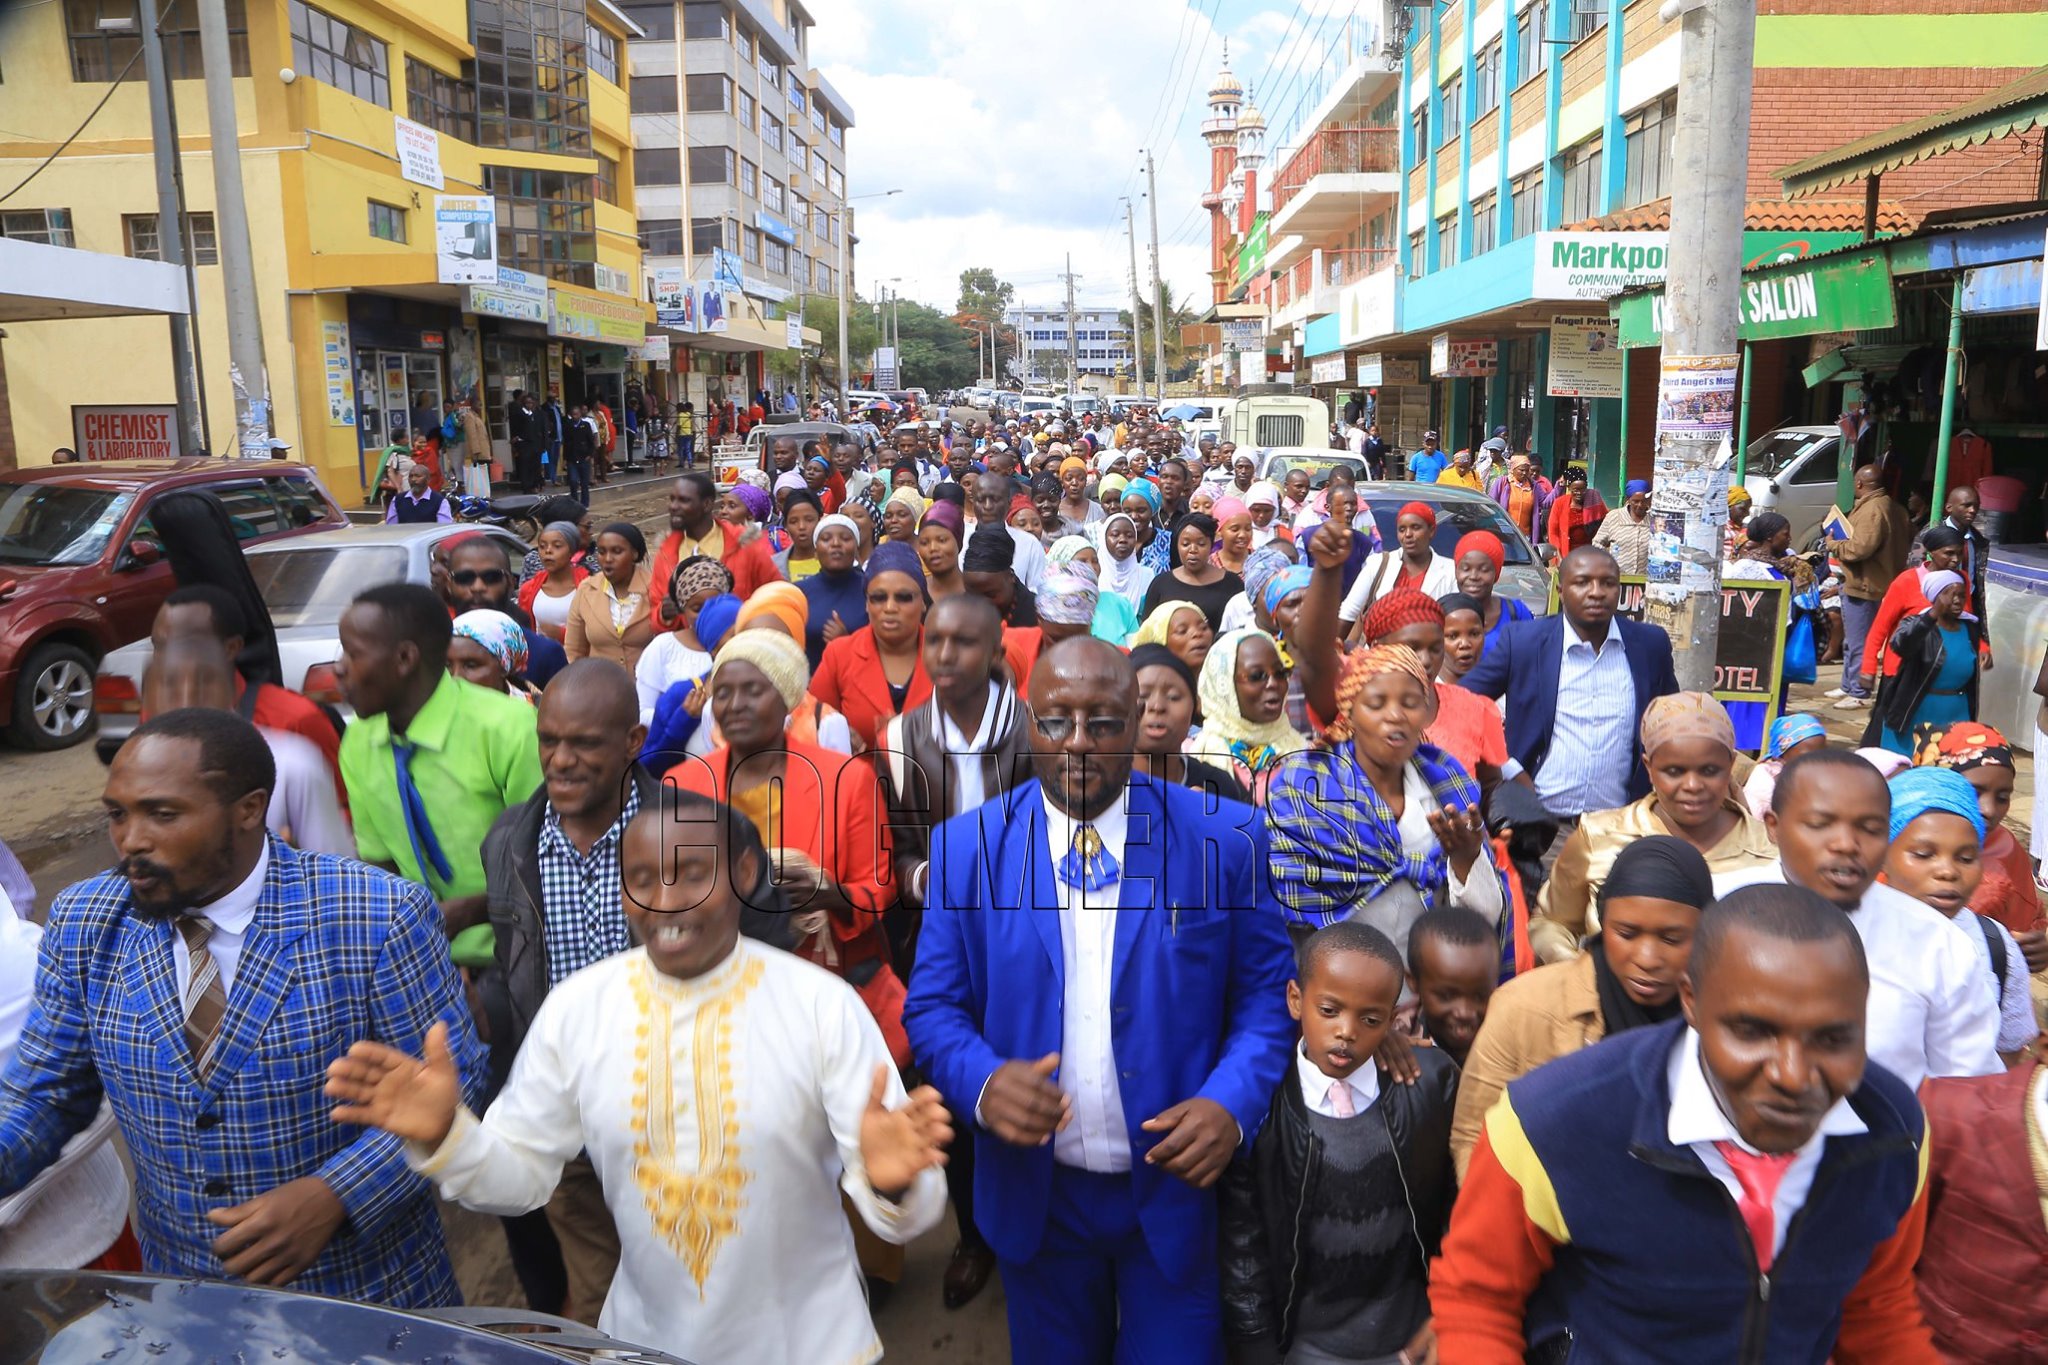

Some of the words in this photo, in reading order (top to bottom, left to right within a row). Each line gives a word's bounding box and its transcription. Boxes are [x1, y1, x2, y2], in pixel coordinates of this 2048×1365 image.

[659, 285, 679, 293] SHOP
[1750, 272, 1818, 323] SALON
[570, 297, 607, 317] PROMISE
[1554, 316, 1583, 327] Angel
[1664, 359, 1690, 367] CHURCH
[1692, 358, 1703, 367] OF
[1663, 378, 1679, 386] Third
[1681, 377, 1714, 386] Angel's
[84, 413, 169, 441] CHEMIST
[87, 442, 96, 461] &
[99, 441, 171, 461] LABORATORY
